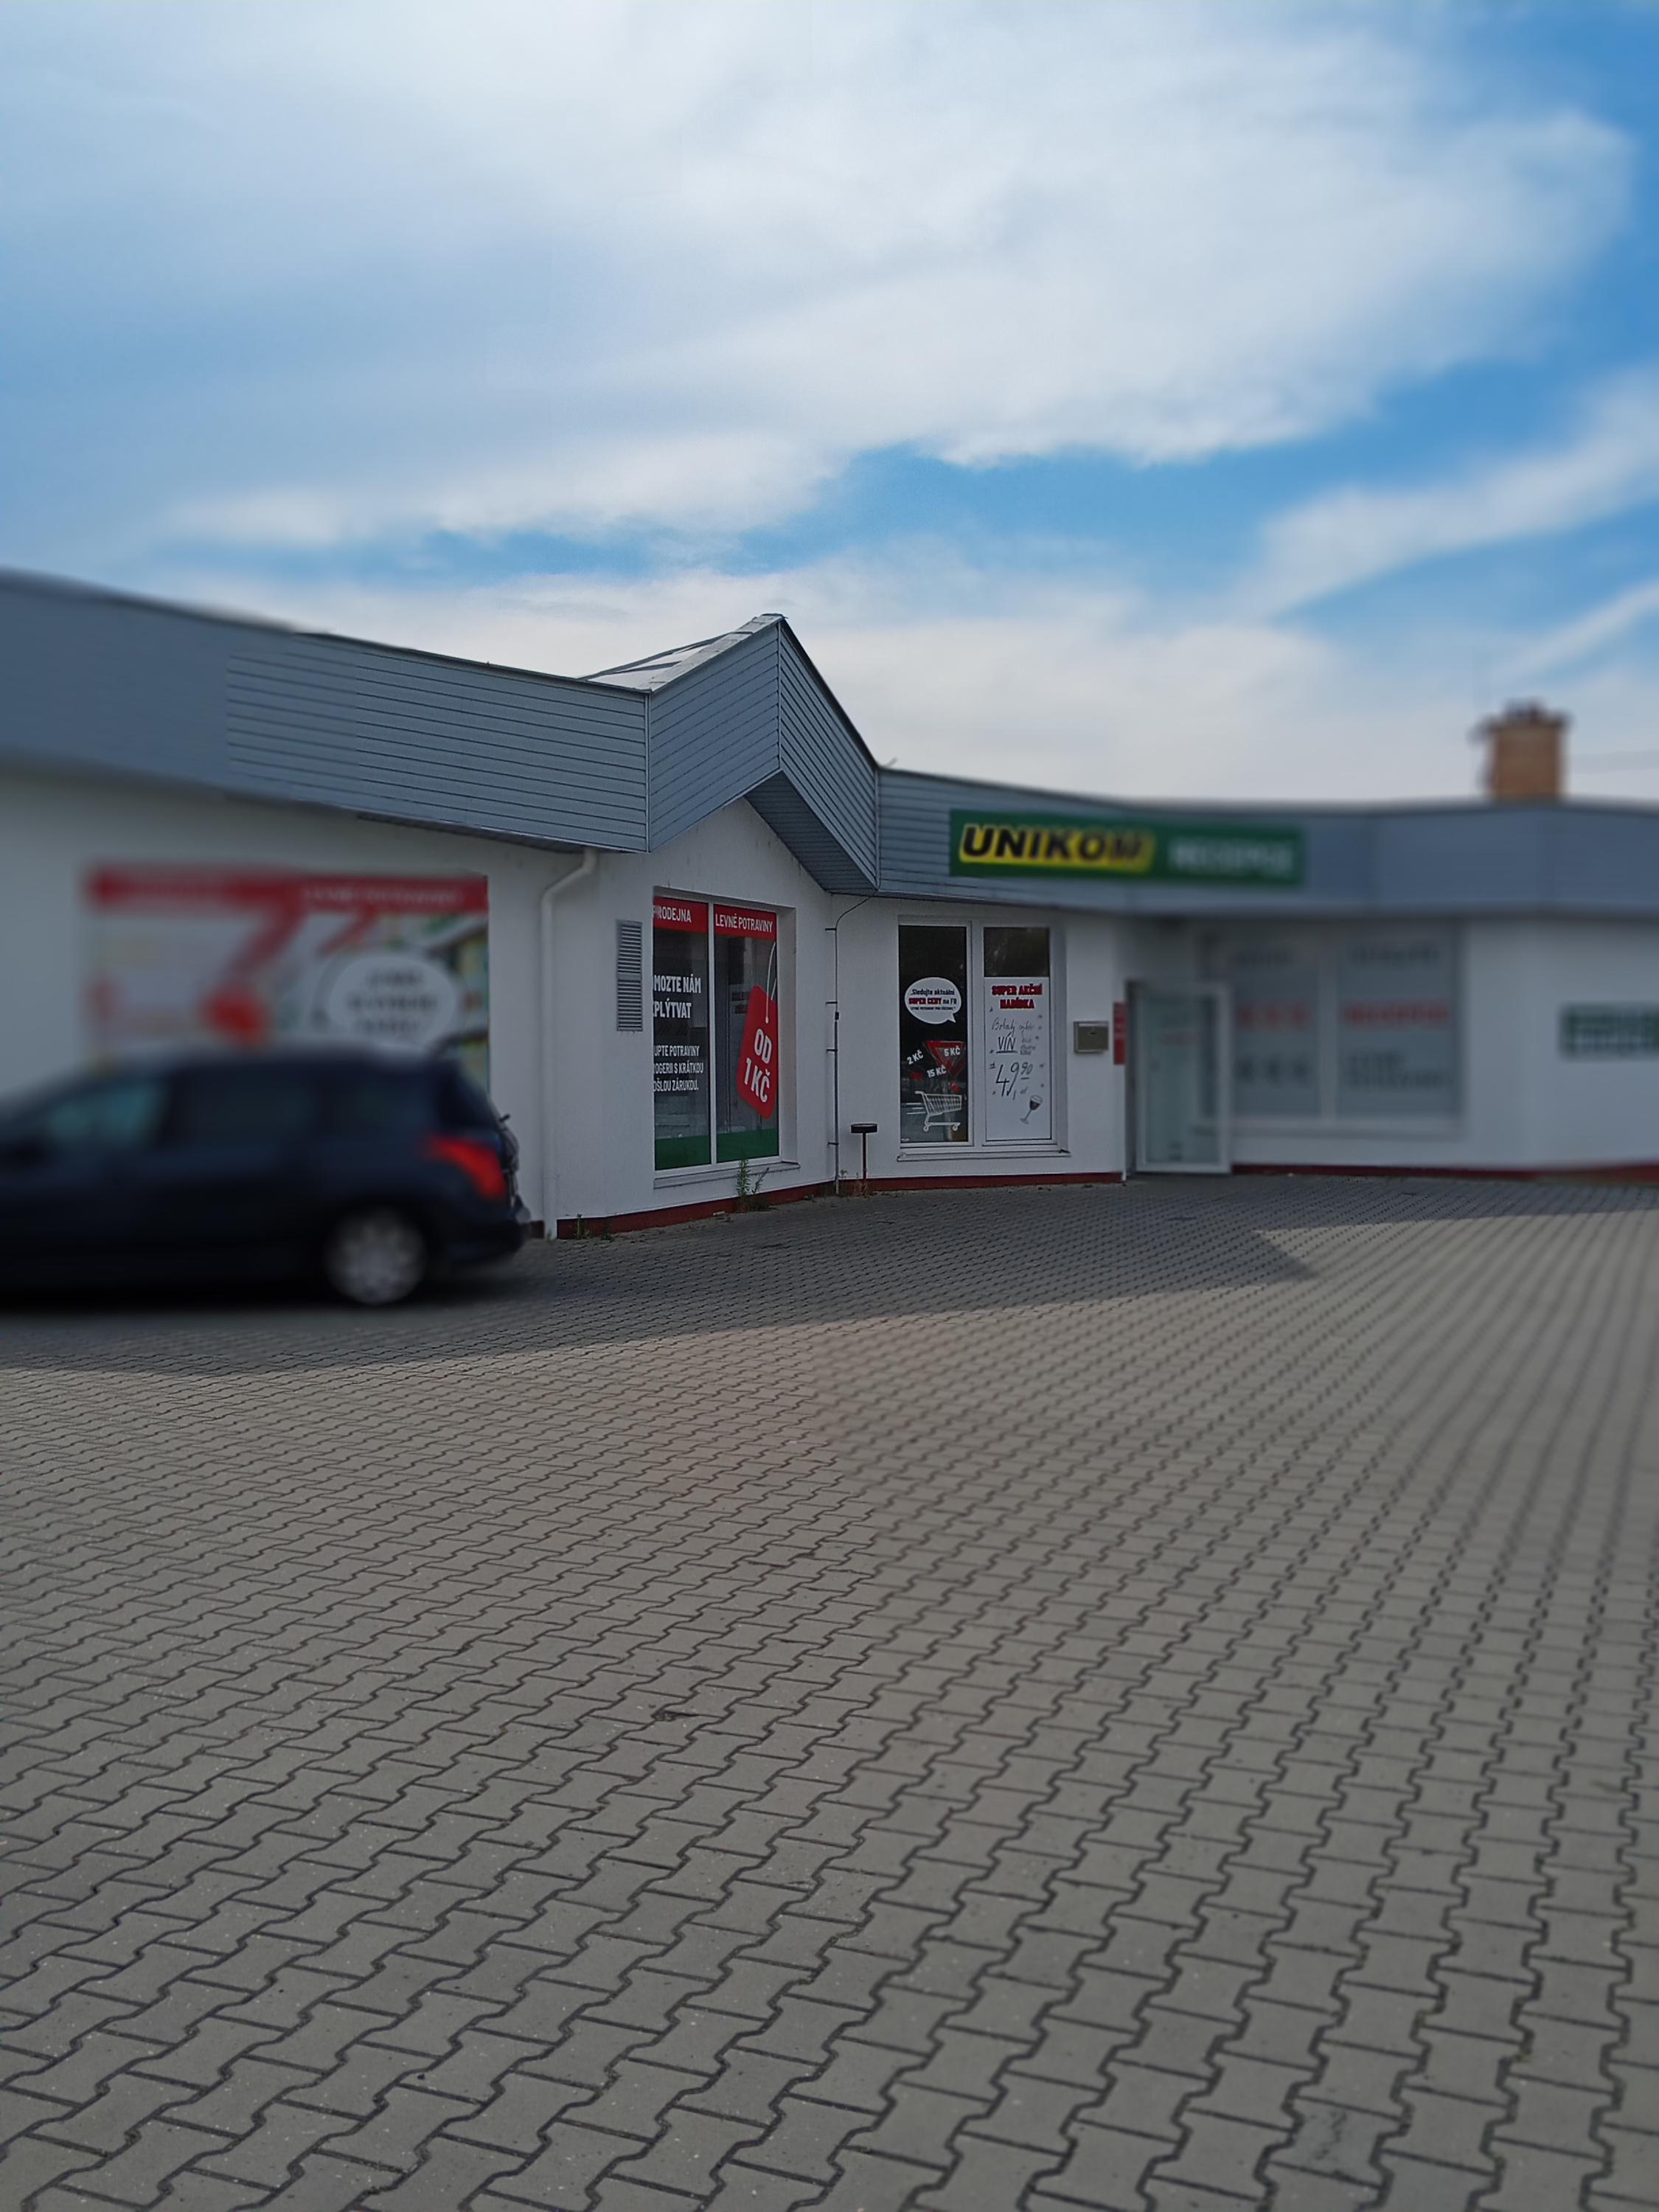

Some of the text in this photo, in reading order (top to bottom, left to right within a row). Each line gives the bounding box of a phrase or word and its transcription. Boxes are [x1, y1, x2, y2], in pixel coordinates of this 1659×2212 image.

[715, 913, 773, 933] LEVNÉ POTRAVINY
[683, 973, 701, 993] NÁM
[653, 998, 692, 1018] PLÝTVAT
[669, 1044, 700, 1057] POTRAVINY
[754, 1028, 772, 1064] OD
[944, 1048, 950, 1057] 5
[679, 1060, 704, 1074] KRÁTKOU
[906, 1056, 914, 1065] 2
[744, 1057, 771, 1102] 1 KČ
[926, 1068, 936, 1078] 15
